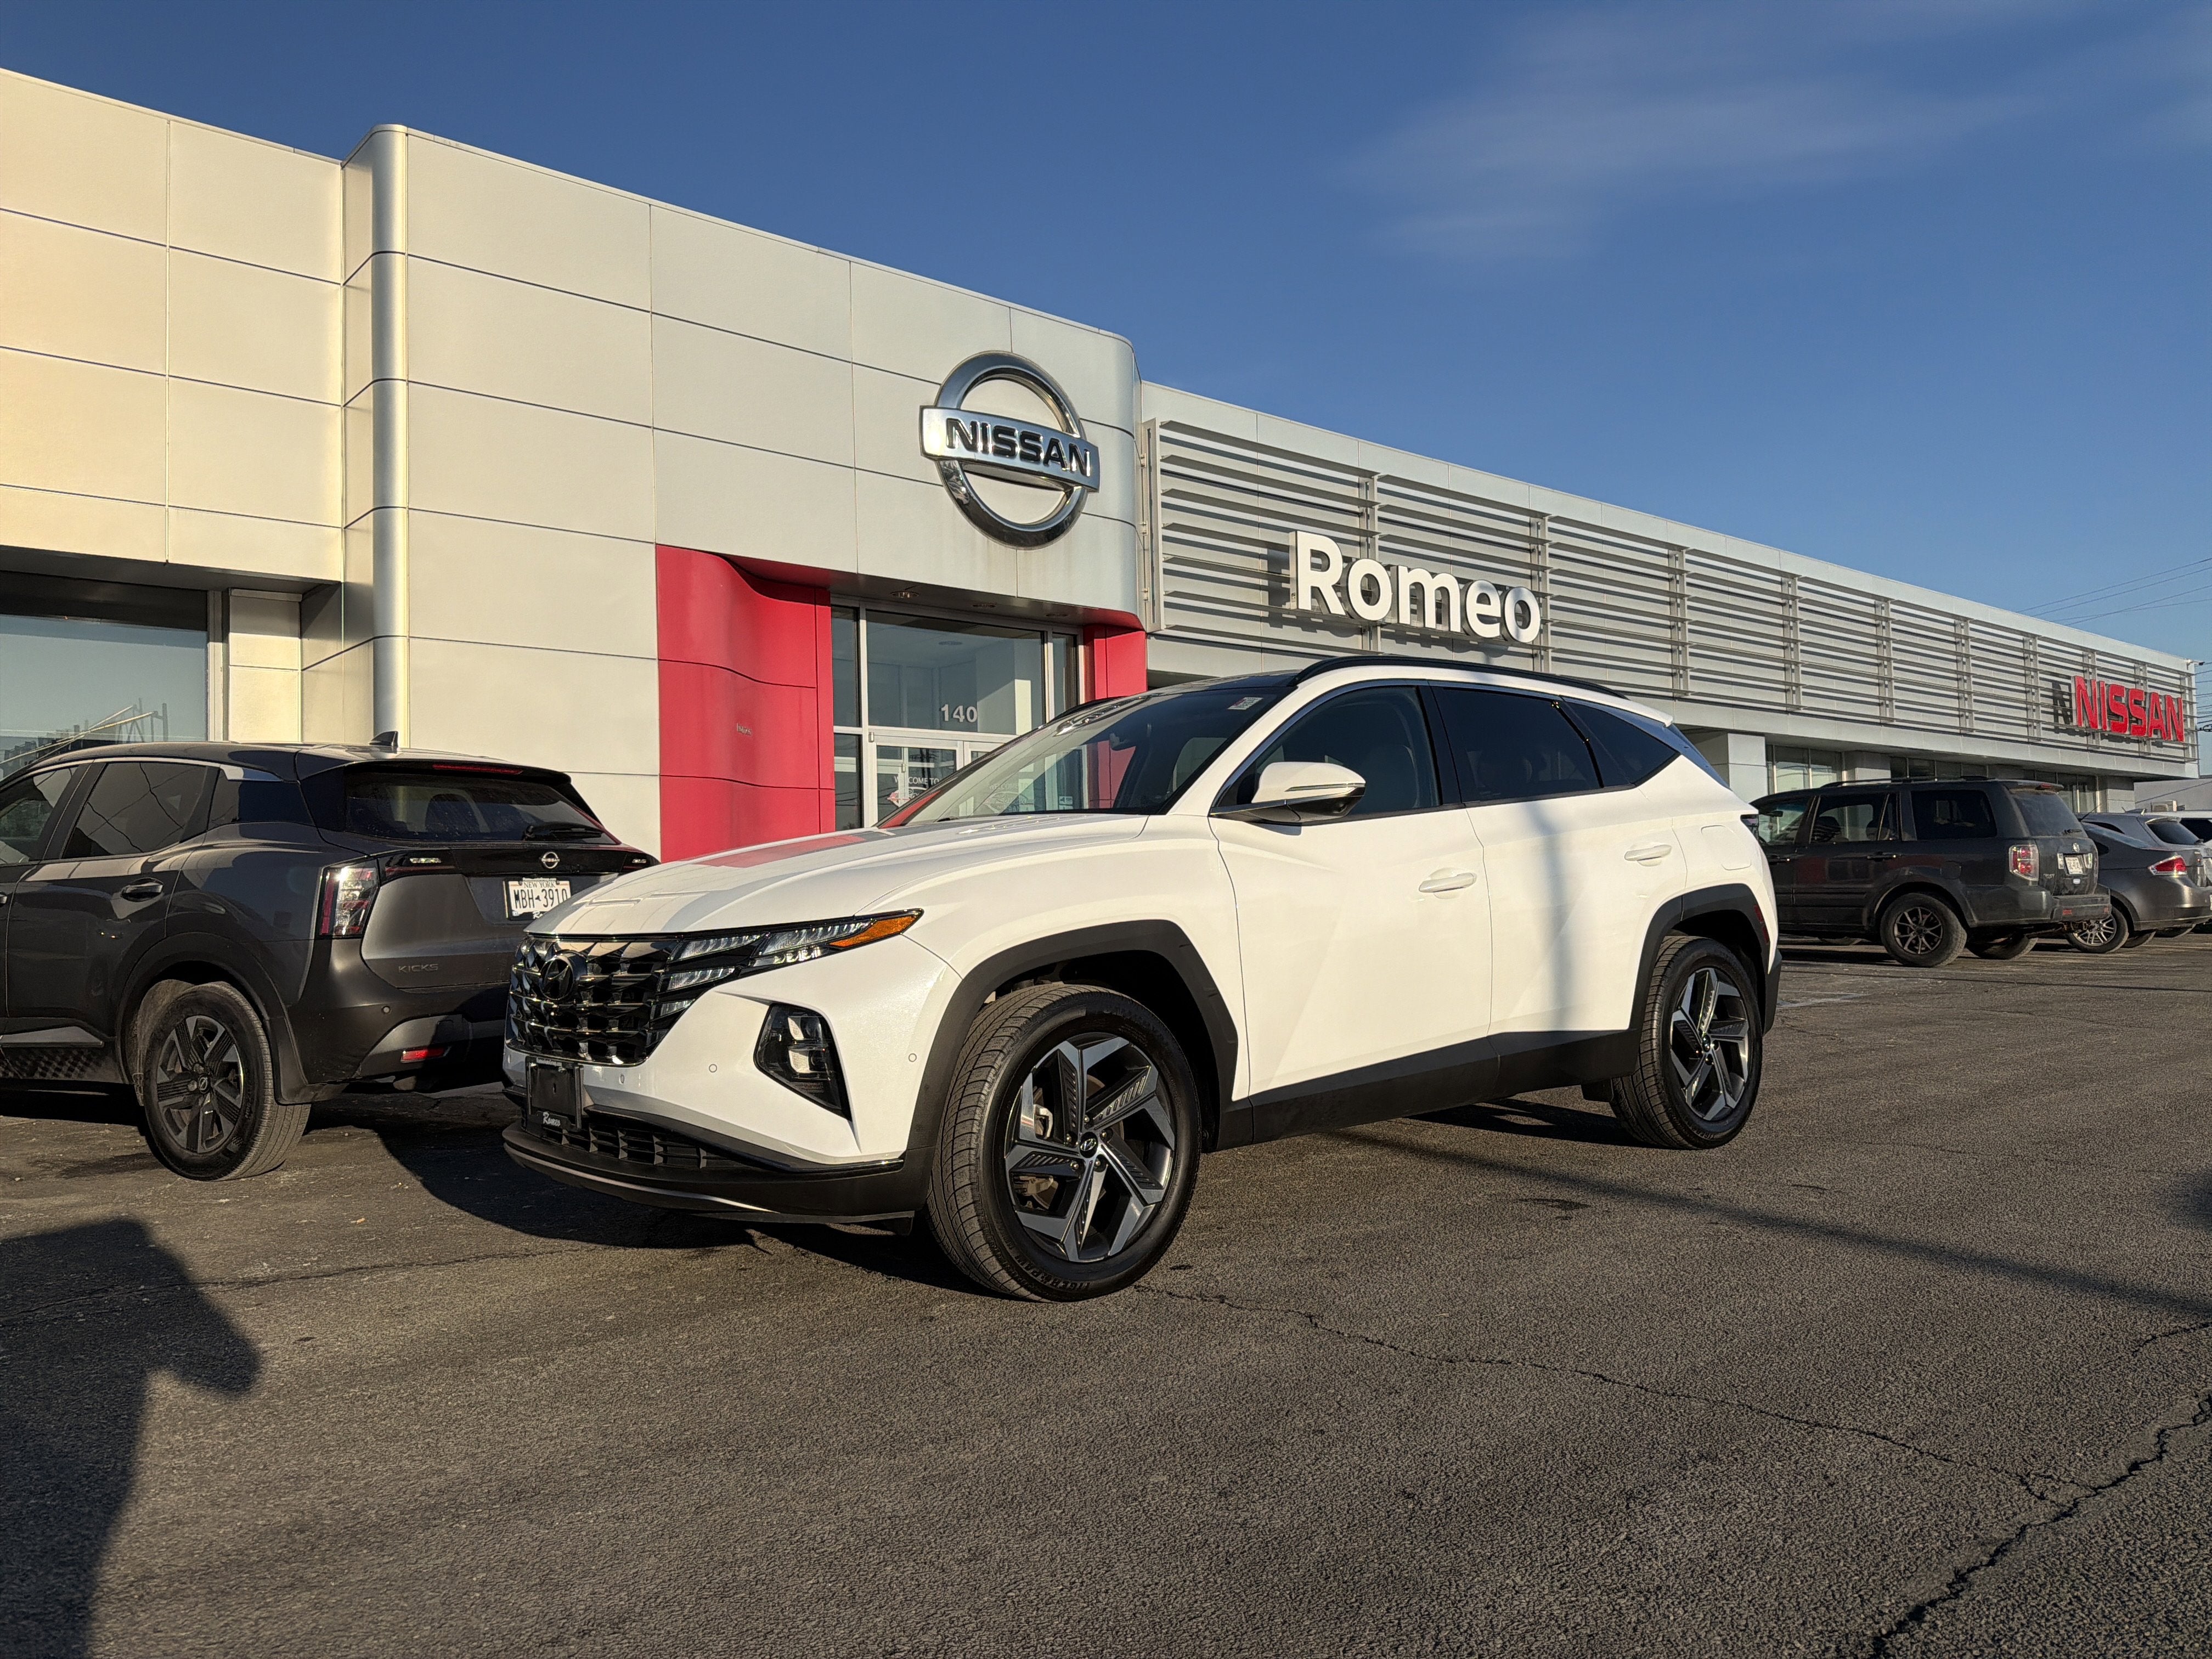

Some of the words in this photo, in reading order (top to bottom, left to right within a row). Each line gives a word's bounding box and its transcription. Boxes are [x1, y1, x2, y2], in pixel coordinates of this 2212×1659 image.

[945, 417, 1092, 478] NISSAN
[1293, 530, 1541, 644] Romeo
[941, 704, 977, 723] 140
[2074, 675, 2186, 742] NISSAN
[893, 775, 928, 785] WCOME
[398, 964, 438, 973] KICKS
